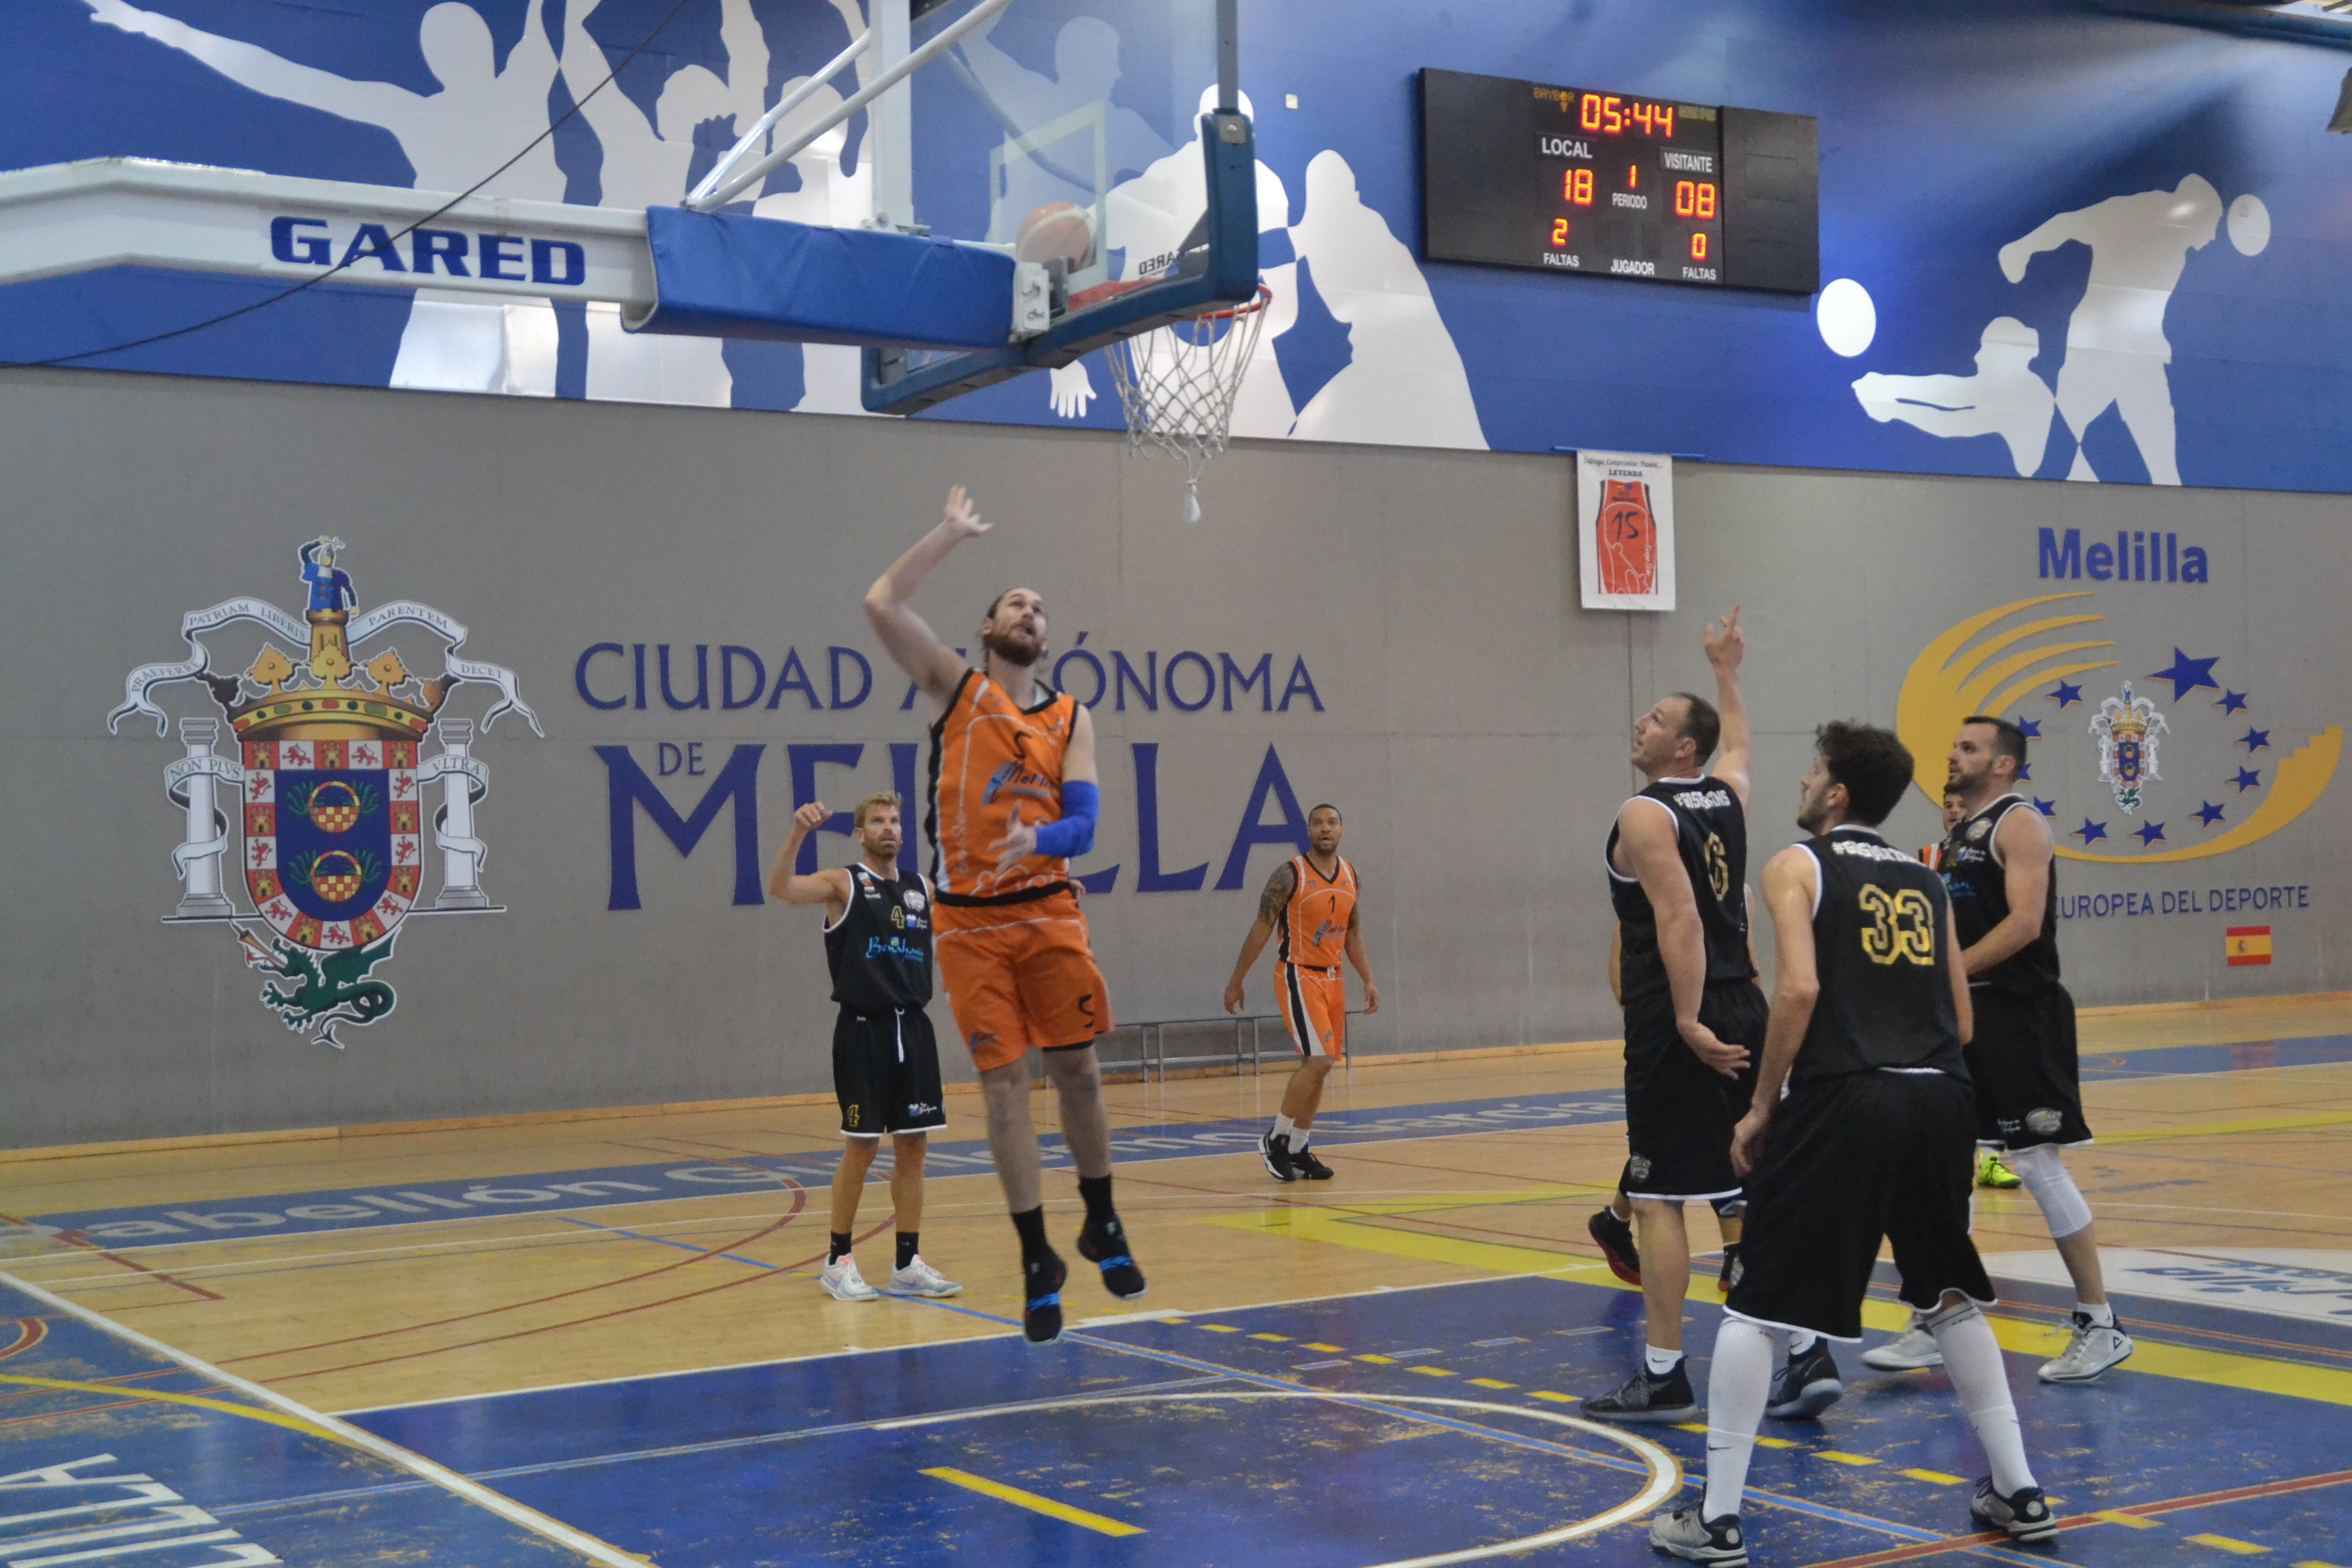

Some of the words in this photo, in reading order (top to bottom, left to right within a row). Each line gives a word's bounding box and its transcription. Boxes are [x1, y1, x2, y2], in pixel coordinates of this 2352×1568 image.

[1580, 93, 1674, 137] 05:44
[1541, 137, 1593, 159] LOCAL
[1664, 152, 1713, 173] VISITANTE
[1565, 168, 1594, 205] 18
[1629, 165, 1637, 188] 1
[1612, 192, 1648, 209] PERIODO
[1675, 180, 1716, 219] 08
[1552, 218, 1569, 245] 2
[271, 216, 585, 287] GARED
[1543, 252, 1580, 267] FALTAS
[1690, 233, 1707, 259] 0
[1610, 259, 1656, 276] JUGADOR
[1682, 266, 1717, 281] FALTAS
[1612, 510, 1639, 540] 15
[2038, 527, 2209, 583] Melilla
[189, 603, 251, 626] PATRIAM
[260, 607, 306, 641] LIBERIS
[368, 606, 448, 630] PARENTEM
[131, 660, 203, 692] PRAEFERRE
[461, 663, 504, 680] DECET
[575, 642, 873, 710] CIUDAD
[900, 632, 1325, 712] ÓNOMA
[170, 759, 202, 781] NON
[209, 758, 242, 779] PLVS
[432, 756, 482, 776] VLTRA
[659, 742, 706, 777] DE
[594, 742, 1314, 911] MELA
[1703, 831, 1729, 902] 6
[1328, 894, 1336, 915] 1
[2057, 892, 2155, 919] UROPEA
[2161, 890, 2203, 914] DEL
[2209, 885, 2310, 912] DEPORTE
[890, 905, 905, 929] 4
[1858, 883, 1935, 966] 33
[846, 1104, 860, 1128] 4
